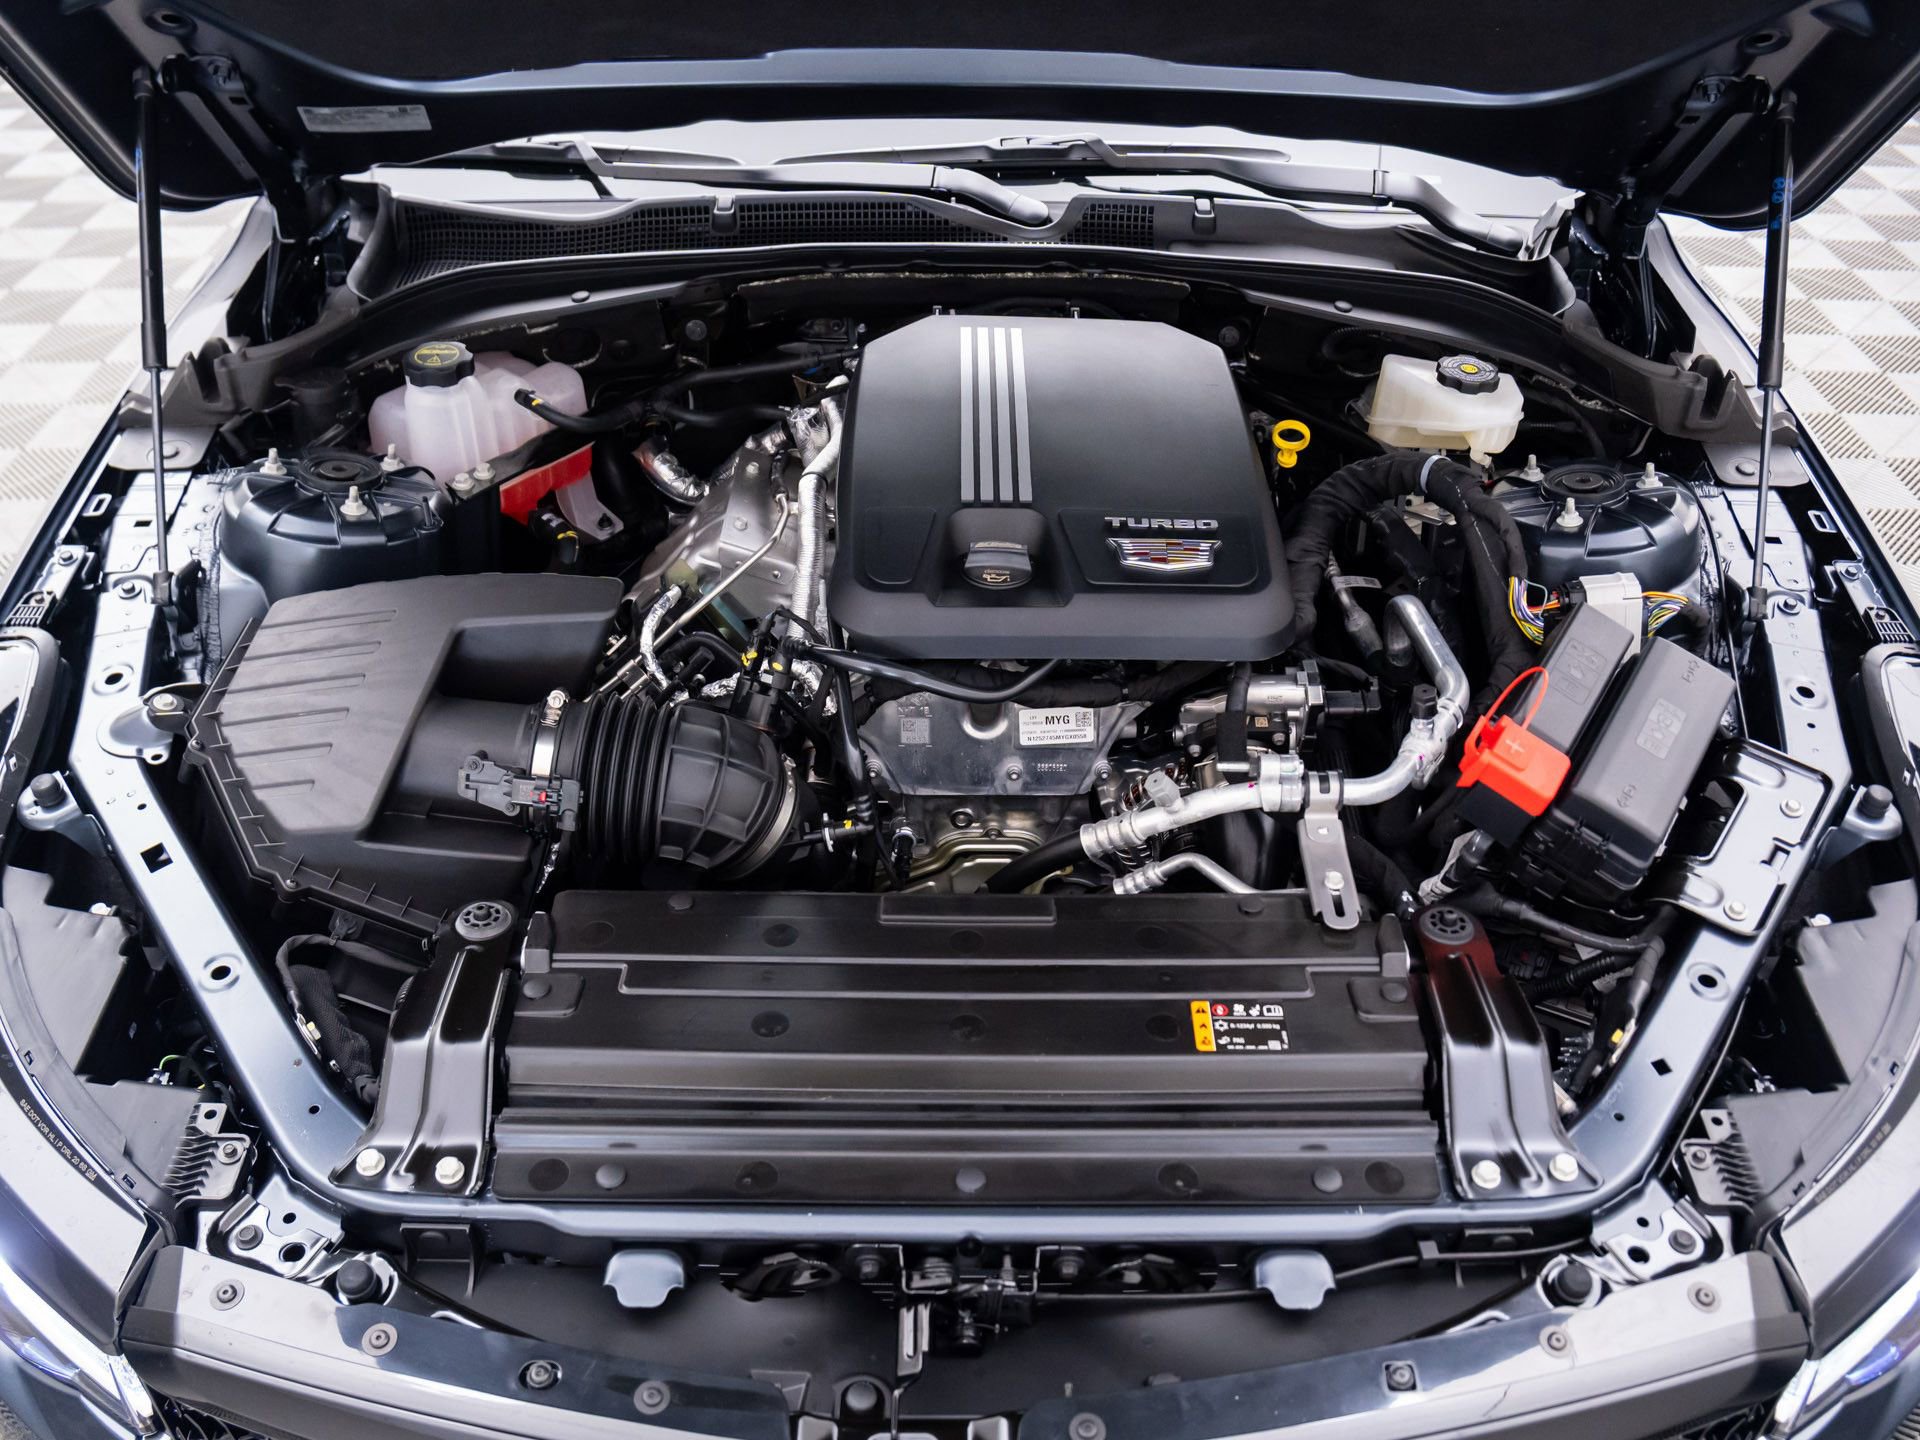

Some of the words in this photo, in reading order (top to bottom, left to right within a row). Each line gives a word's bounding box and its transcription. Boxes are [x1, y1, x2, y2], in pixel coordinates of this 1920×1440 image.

[1104, 516, 1220, 530] TURBO
[1045, 715, 1070, 725] MYG
[28, 1110, 40, 1124] DOT
